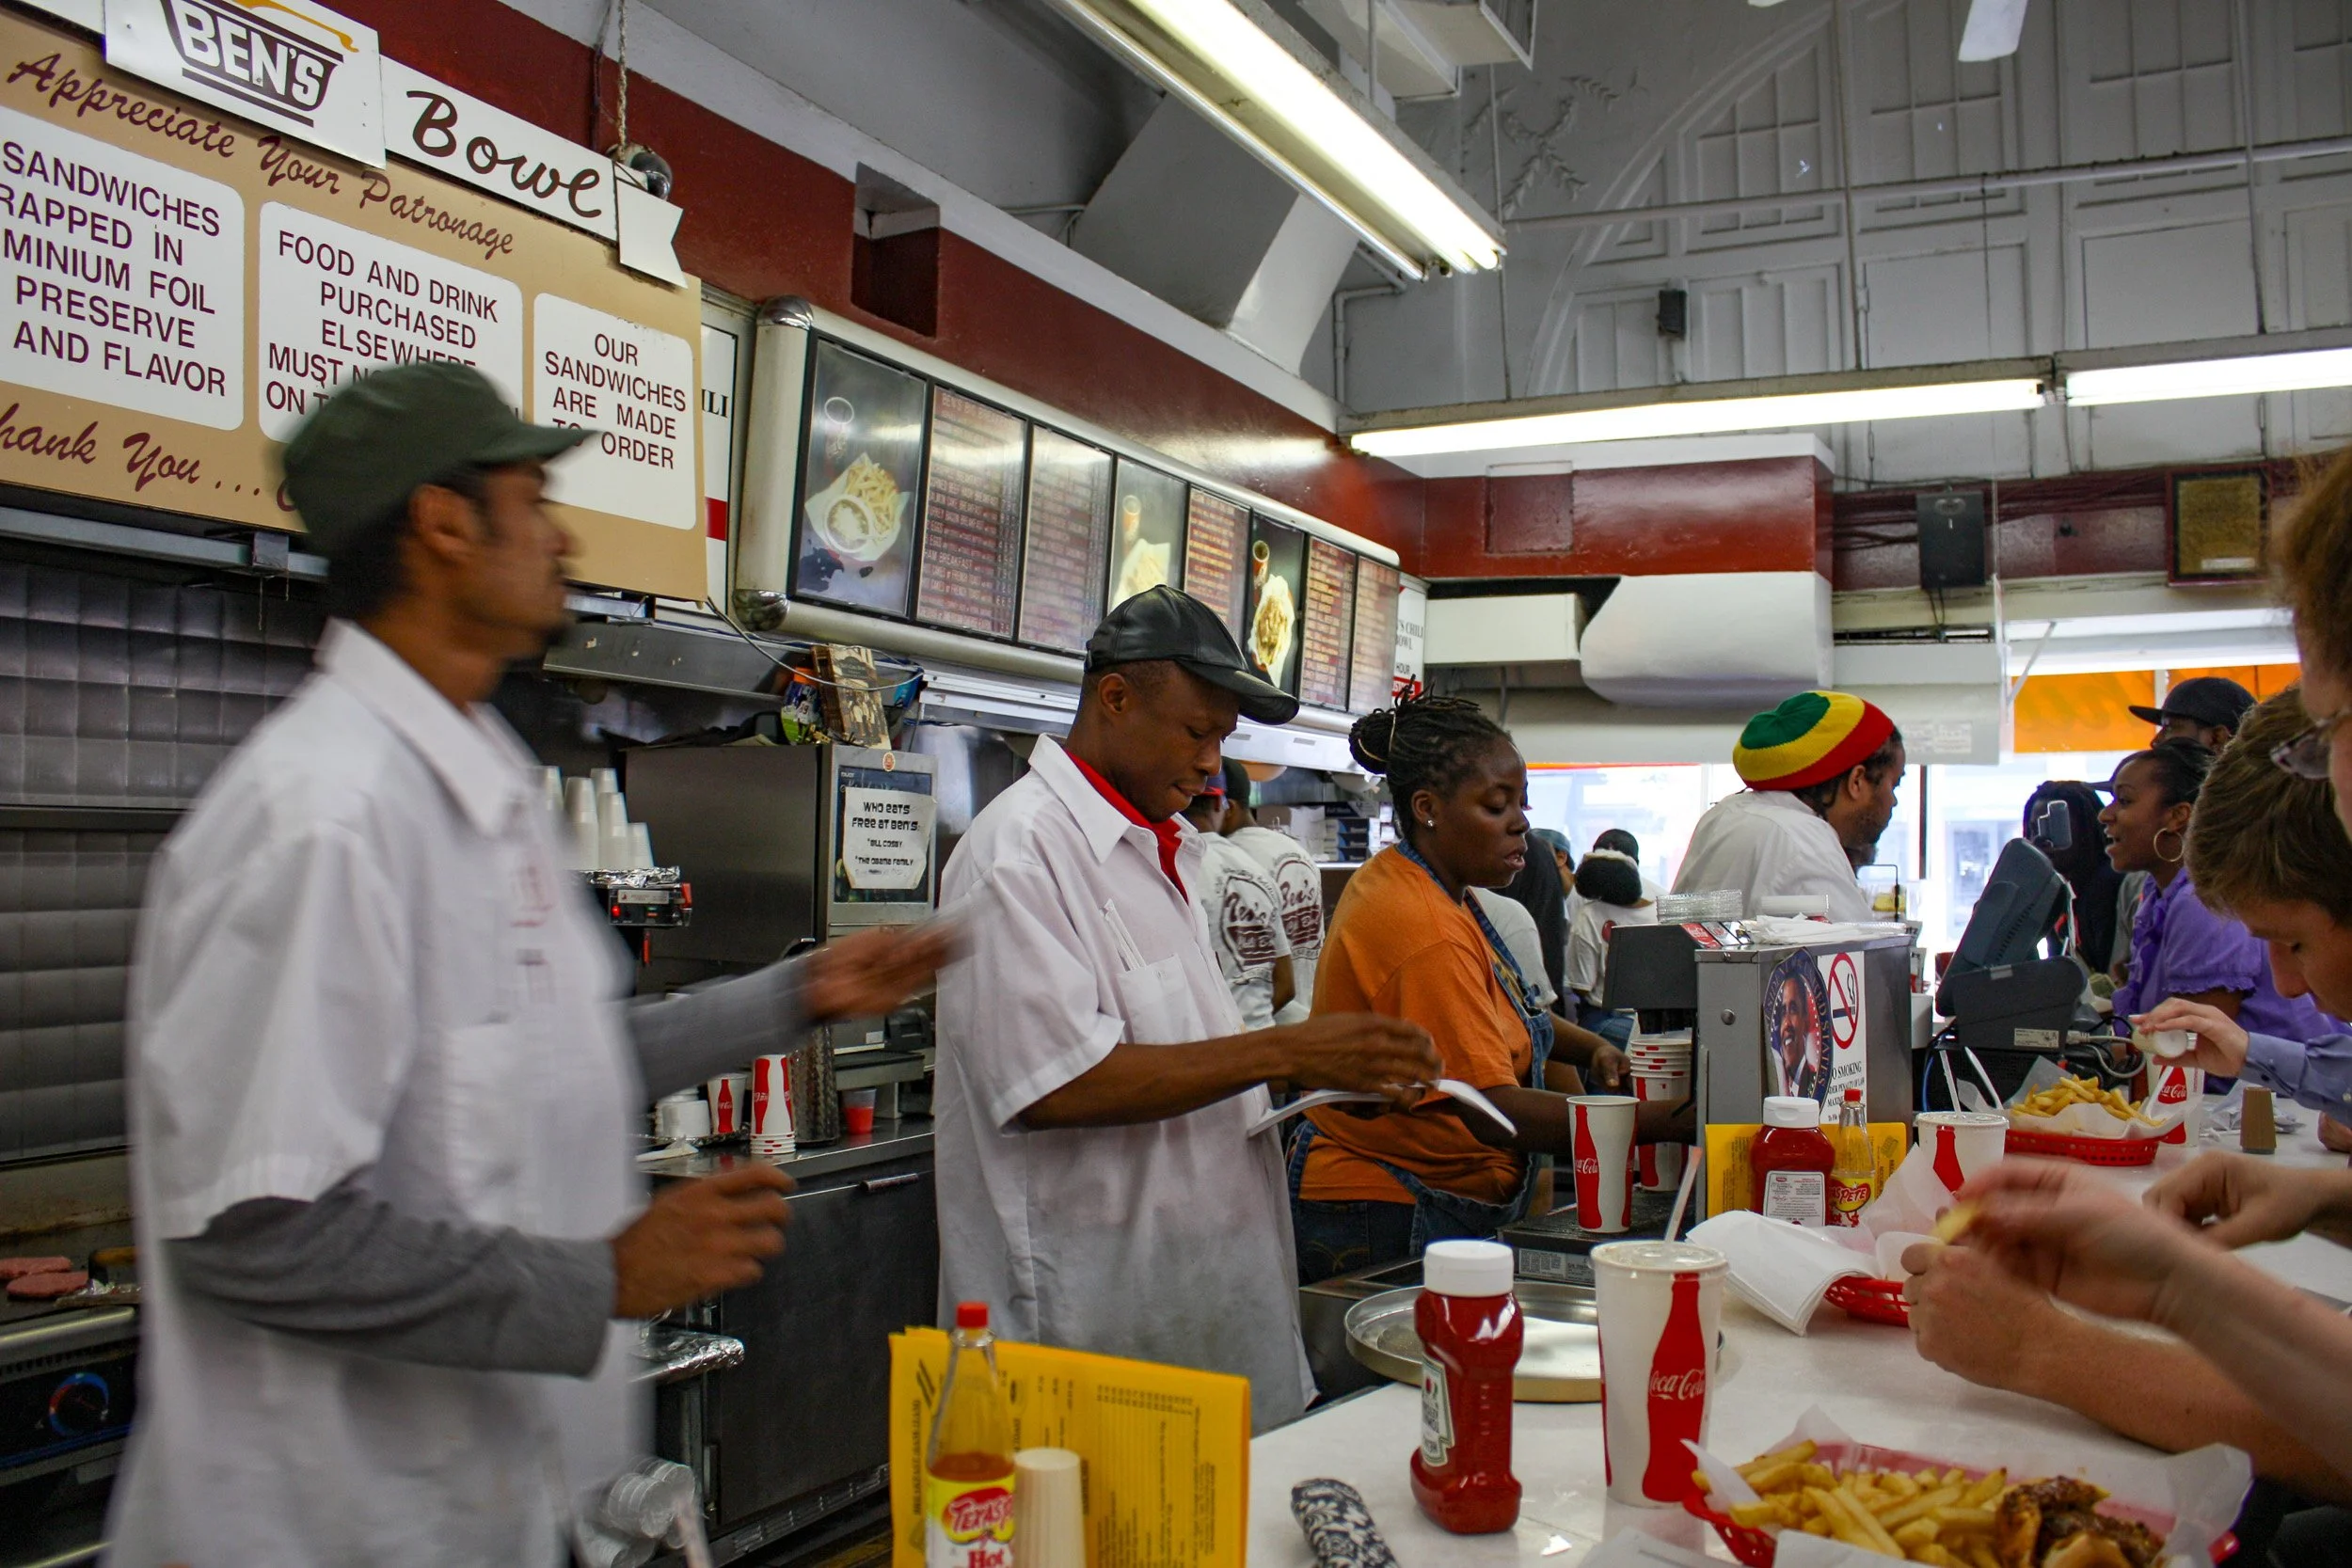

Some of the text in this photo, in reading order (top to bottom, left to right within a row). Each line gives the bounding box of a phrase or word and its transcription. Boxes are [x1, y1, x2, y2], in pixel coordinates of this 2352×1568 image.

[178, 2, 326, 107] BEN'S
[7, 53, 513, 260] Appreciate Your Patronage
[3, 141, 220, 238] SANDWICHES
[4, 228, 215, 315] MINIUM FOIL
[154, 230, 183, 266] IN
[278, 230, 499, 324] FOOD AND DRINK
[17, 276, 196, 349] PRESERVE
[321, 281, 477, 349] PURCHASED
[13, 321, 225, 396] AND FLAVOR
[269, 342, 343, 386] MUST
[545, 351, 687, 412] SANDWICHES
[595, 333, 638, 367] OUR
[266, 380, 305, 416] ON
[552, 387, 597, 419] ARE
[617, 404, 676, 440] MADE
[122, 433, 200, 492] You
[601, 432, 674, 470] ORDER
